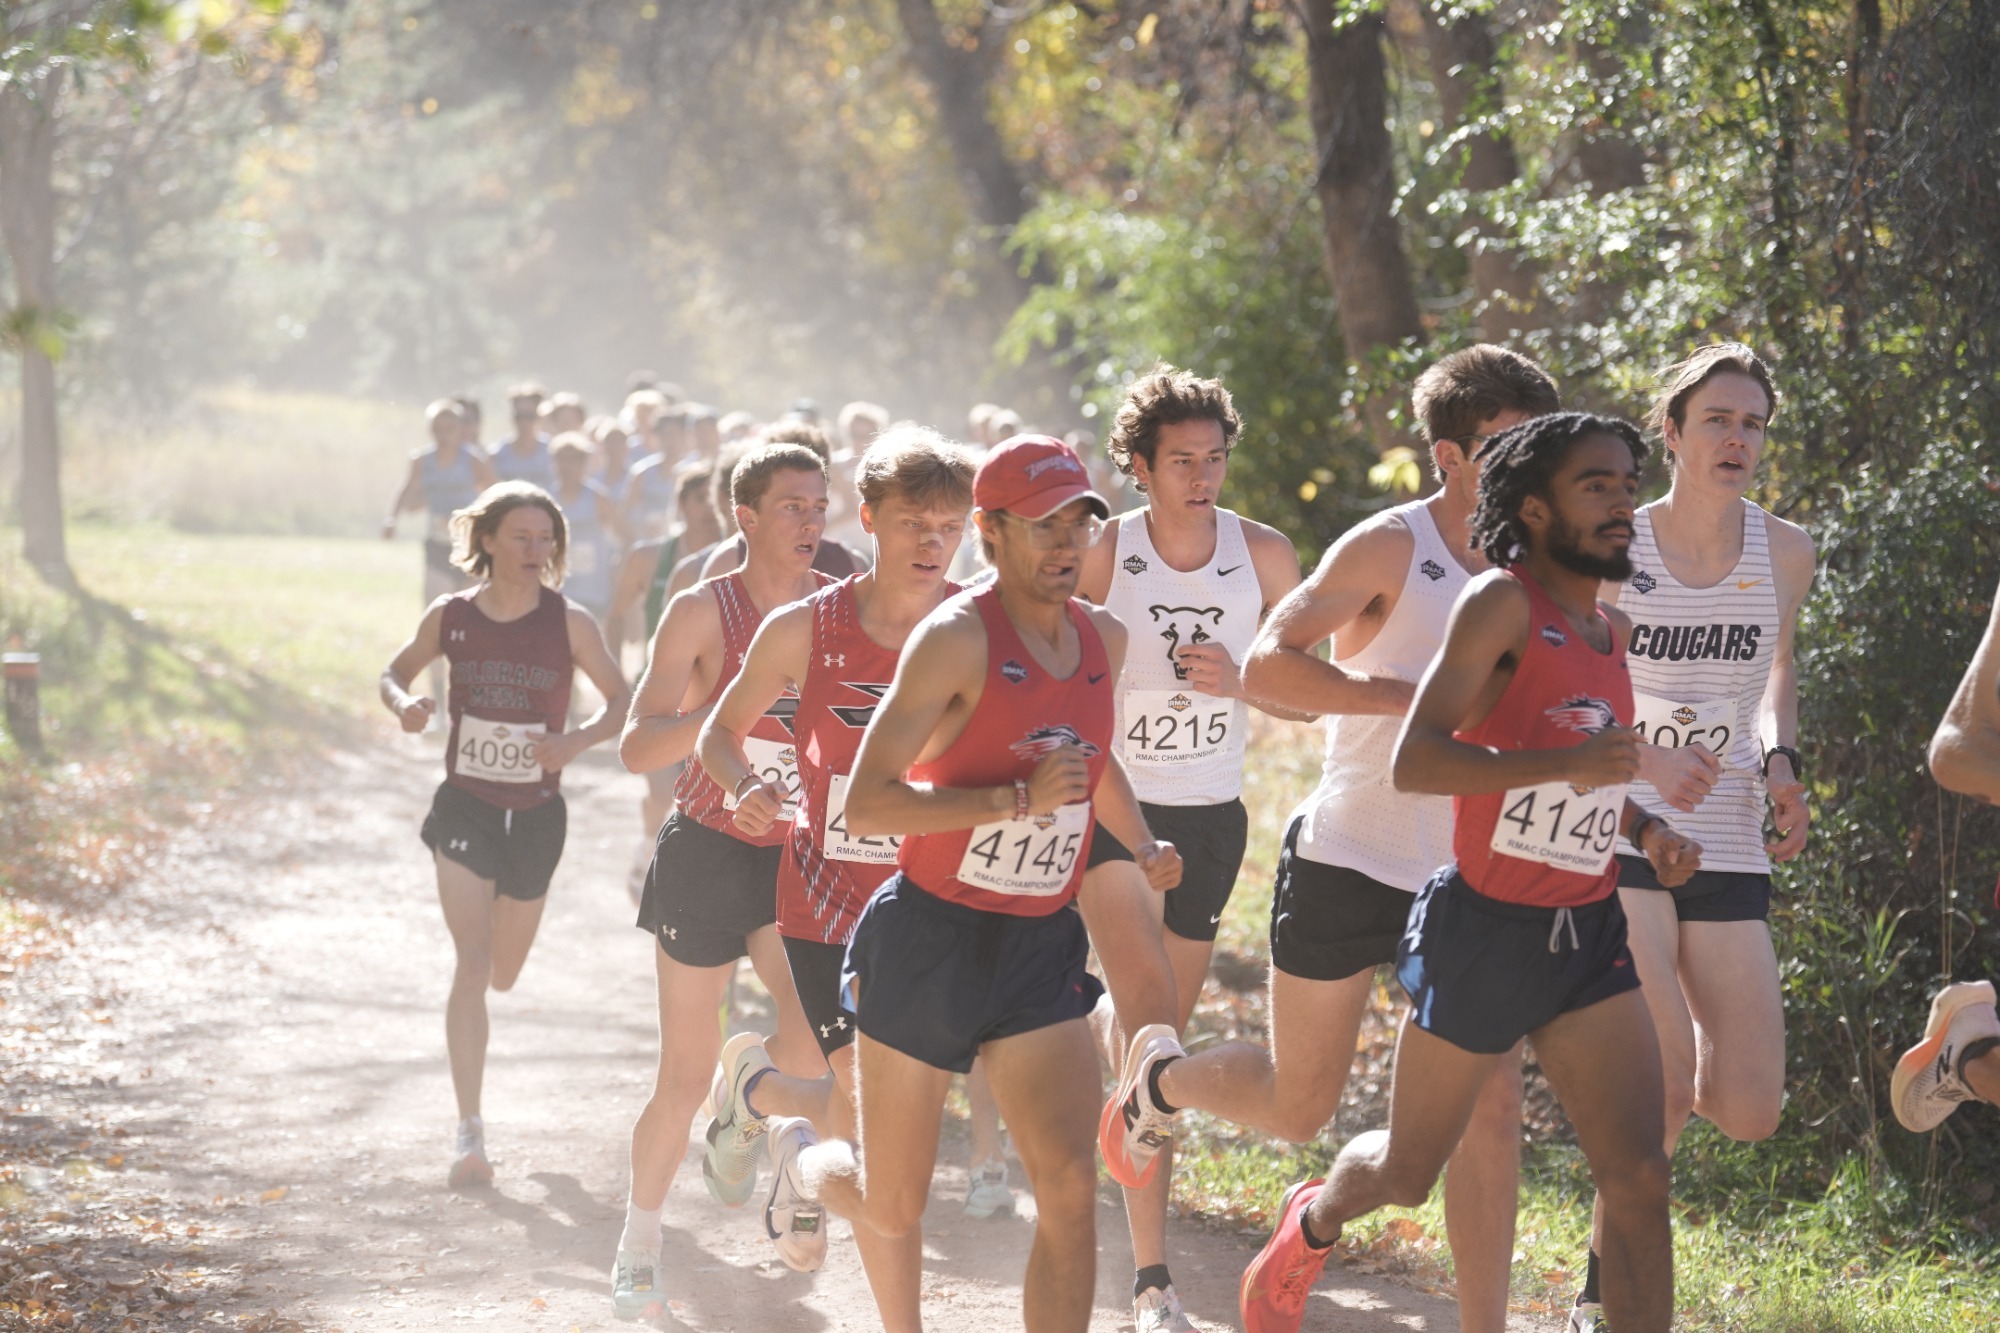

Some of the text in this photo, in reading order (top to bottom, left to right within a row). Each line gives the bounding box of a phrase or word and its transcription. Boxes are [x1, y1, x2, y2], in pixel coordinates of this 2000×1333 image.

[1124, 560, 1147, 569] RMAC
[1422, 564, 1445, 576] RMAC
[1633, 577, 1656, 589] RMAC
[1629, 624, 1762, 661] COUGARS
[1002, 665, 1027, 678] RMAC
[469, 687, 530, 710] MESA
[1673, 712, 1697, 720] RMAC
[1127, 712, 1228, 750] 4215
[460, 737, 538, 770] 4099
[1135, 748, 1218, 762] RMAC CHAMPIONSHIP
[1504, 790, 1617, 853] 4149
[836, 846, 862, 856] RMAC
[970, 829, 1081, 876] 4145
[1506, 839, 1602, 868] RMAC CHAMPIONSHIP
[973, 871, 1003, 886] RMAC
